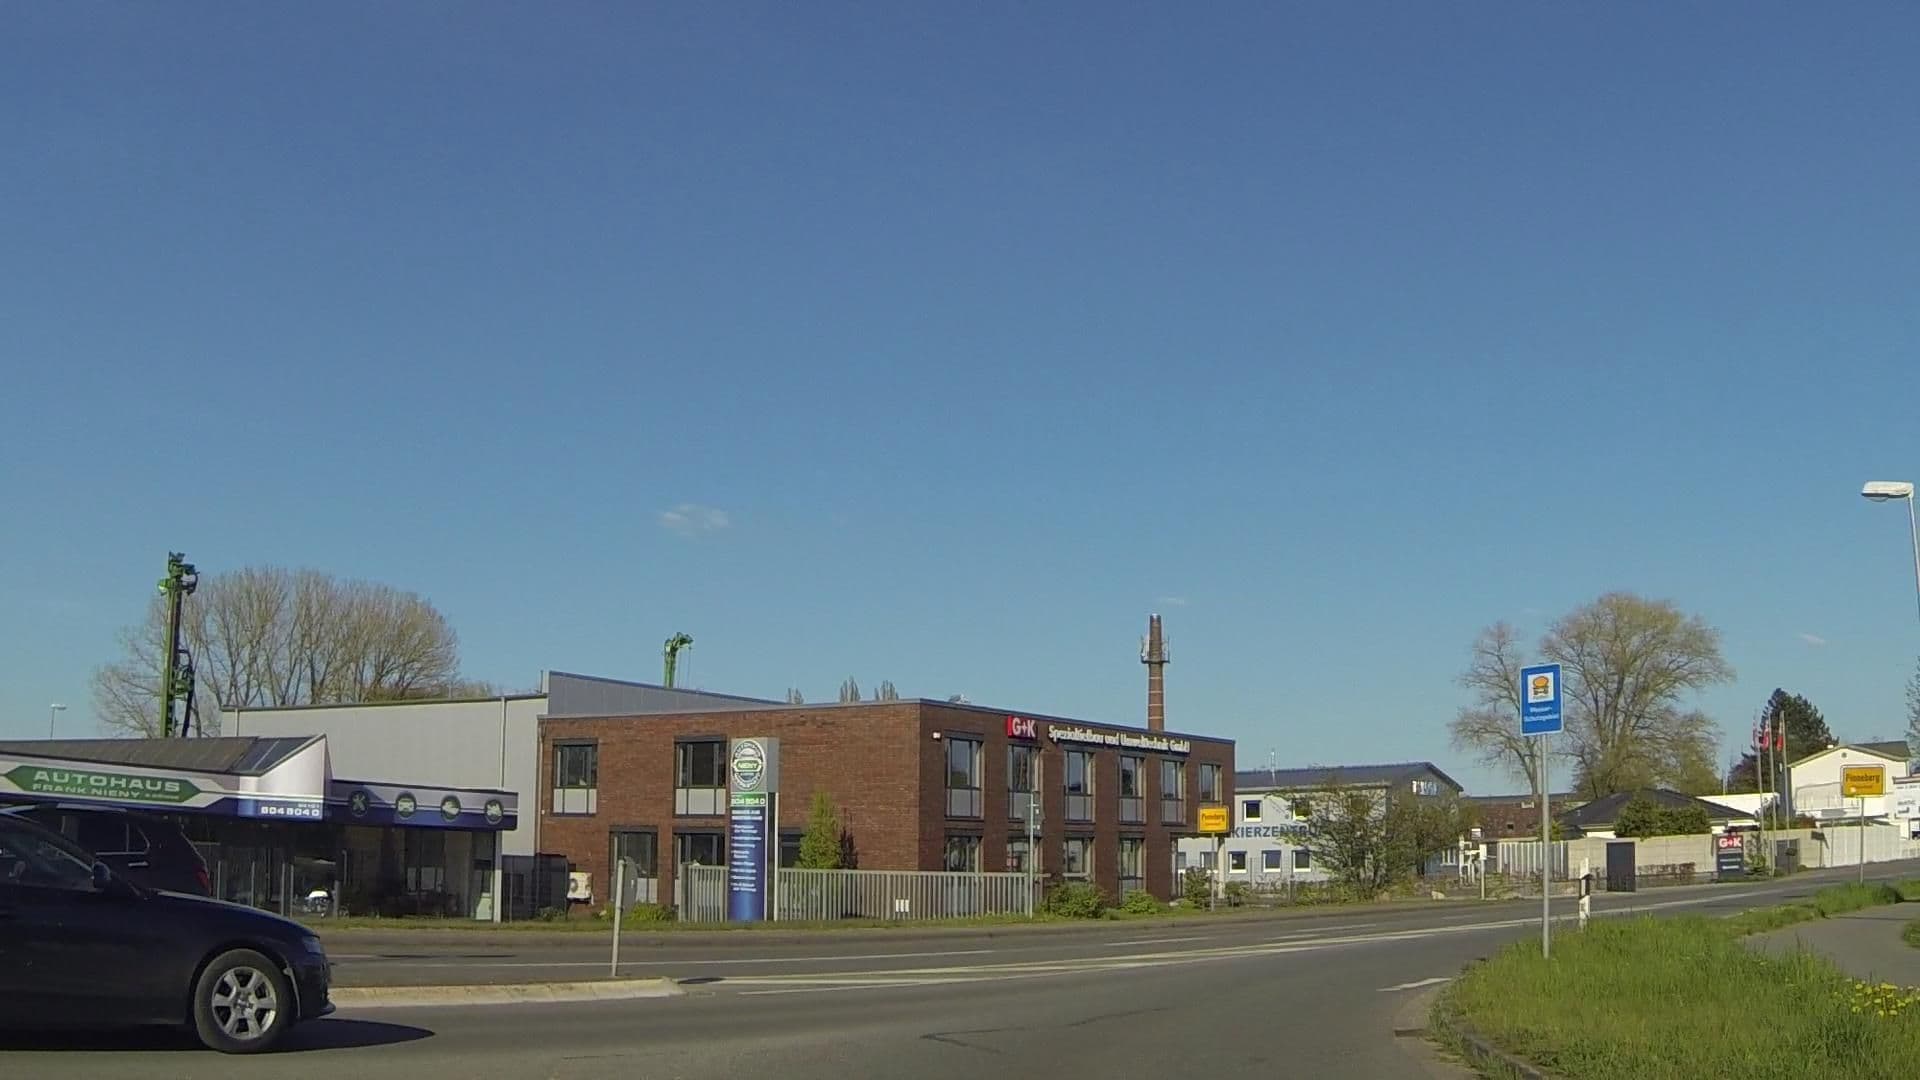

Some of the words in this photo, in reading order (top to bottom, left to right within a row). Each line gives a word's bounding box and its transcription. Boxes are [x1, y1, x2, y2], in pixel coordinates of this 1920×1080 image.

[1012, 717, 1036, 738] G+K
[1105, 732, 1119, 746] und
[1169, 738, 1191, 753] GmbH
[33, 770, 181, 793] AUTOHAUS
[1845, 773, 1881, 784] Pinneberg
[32, 783, 87, 795] FRANK
[91, 788, 141, 799] NIENY
[1719, 837, 1742, 848] G+K
